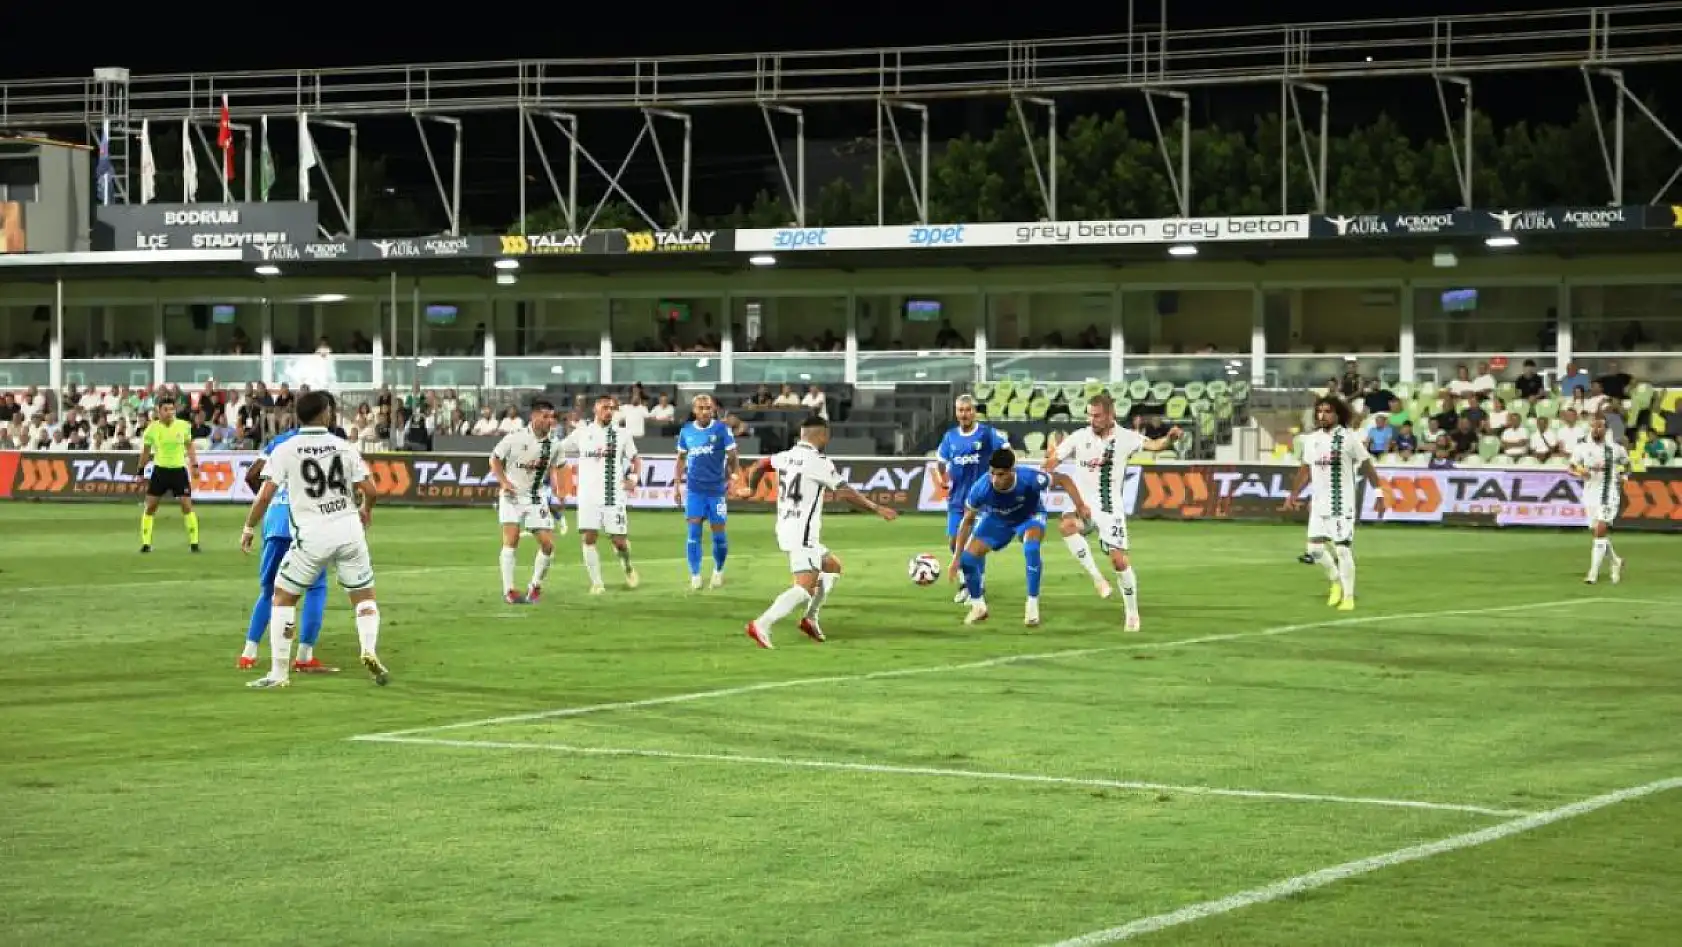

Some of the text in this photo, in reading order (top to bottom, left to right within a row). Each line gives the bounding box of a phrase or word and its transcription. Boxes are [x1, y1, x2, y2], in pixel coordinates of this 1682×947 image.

[165, 210, 239, 225] BODRUM
[1162, 216, 1299, 239] grey beton
[527, 235, 588, 247] TALAY
[655, 231, 716, 244] TALAY
[1016, 221, 1146, 243] grey beton
[72, 459, 153, 482] TAL
[301, 453, 347, 498] 94
[1447, 477, 1585, 503] TALA
